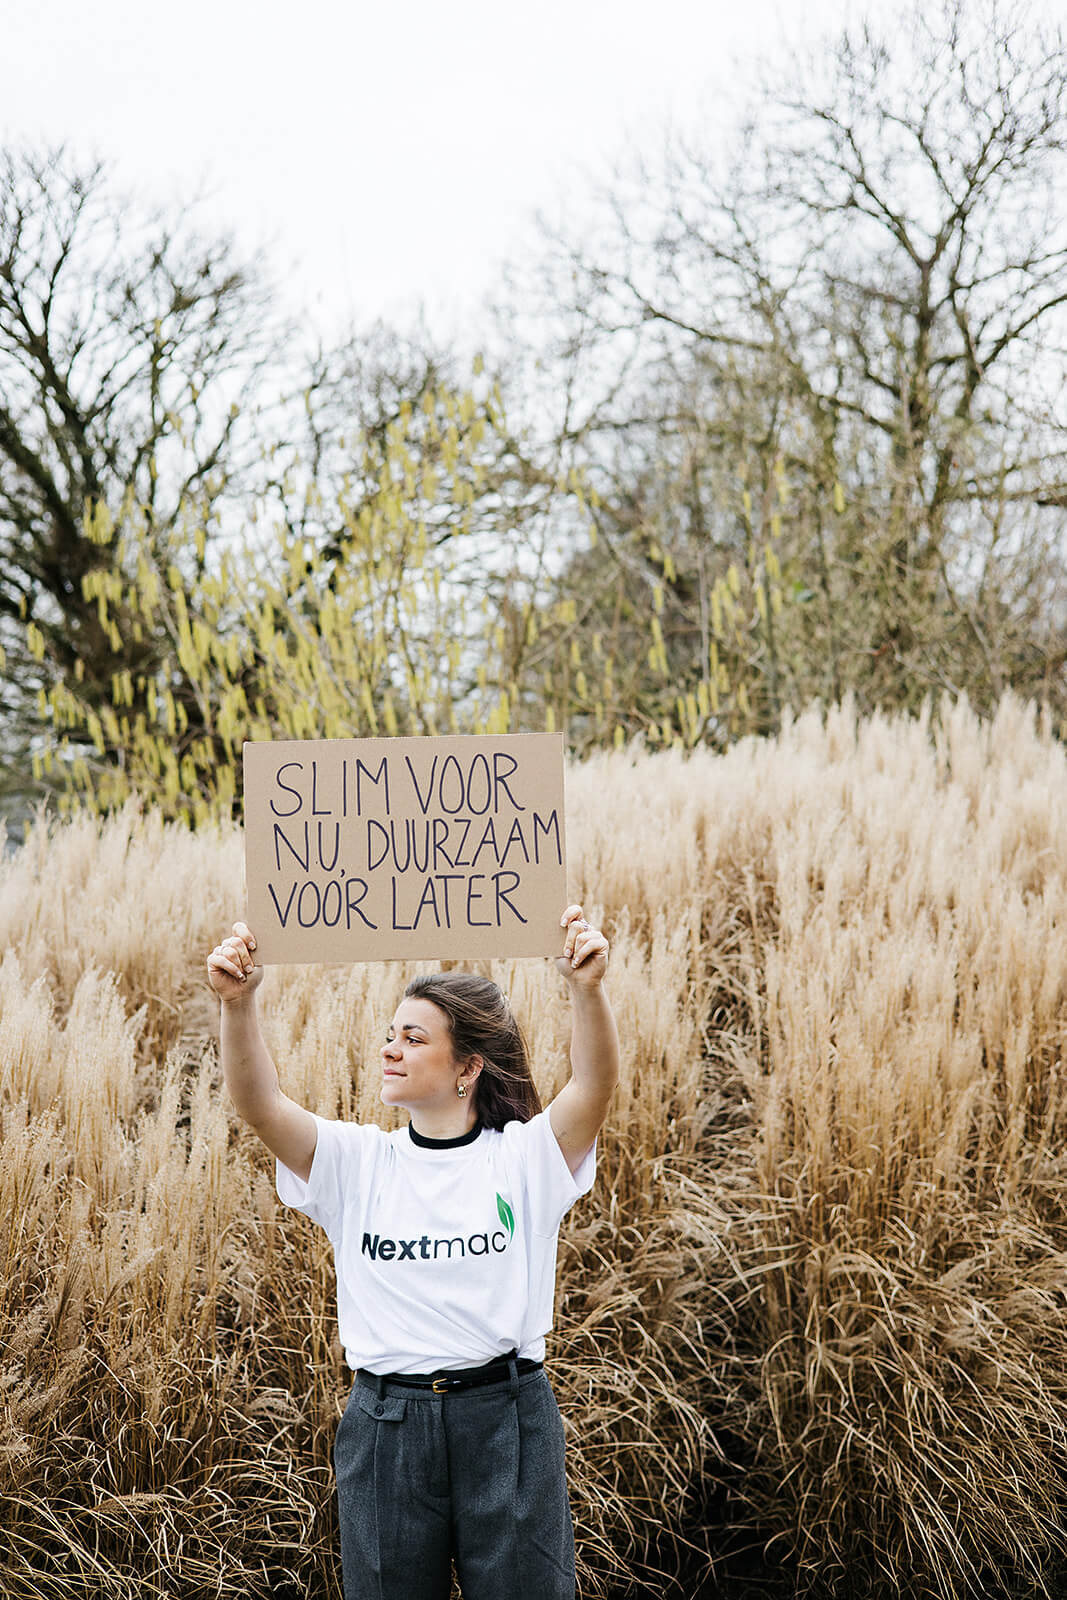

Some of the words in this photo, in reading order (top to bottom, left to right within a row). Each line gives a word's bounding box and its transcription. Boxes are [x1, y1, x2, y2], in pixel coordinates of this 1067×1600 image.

[269, 755, 391, 817] SLIM
[404, 752, 526, 816] VOOR
[367, 809, 562, 873] DUURZAAM
[267, 877, 378, 930] VOOR
[391, 870, 528, 930] LATER
[361, 1231, 507, 1261] Nextmac
